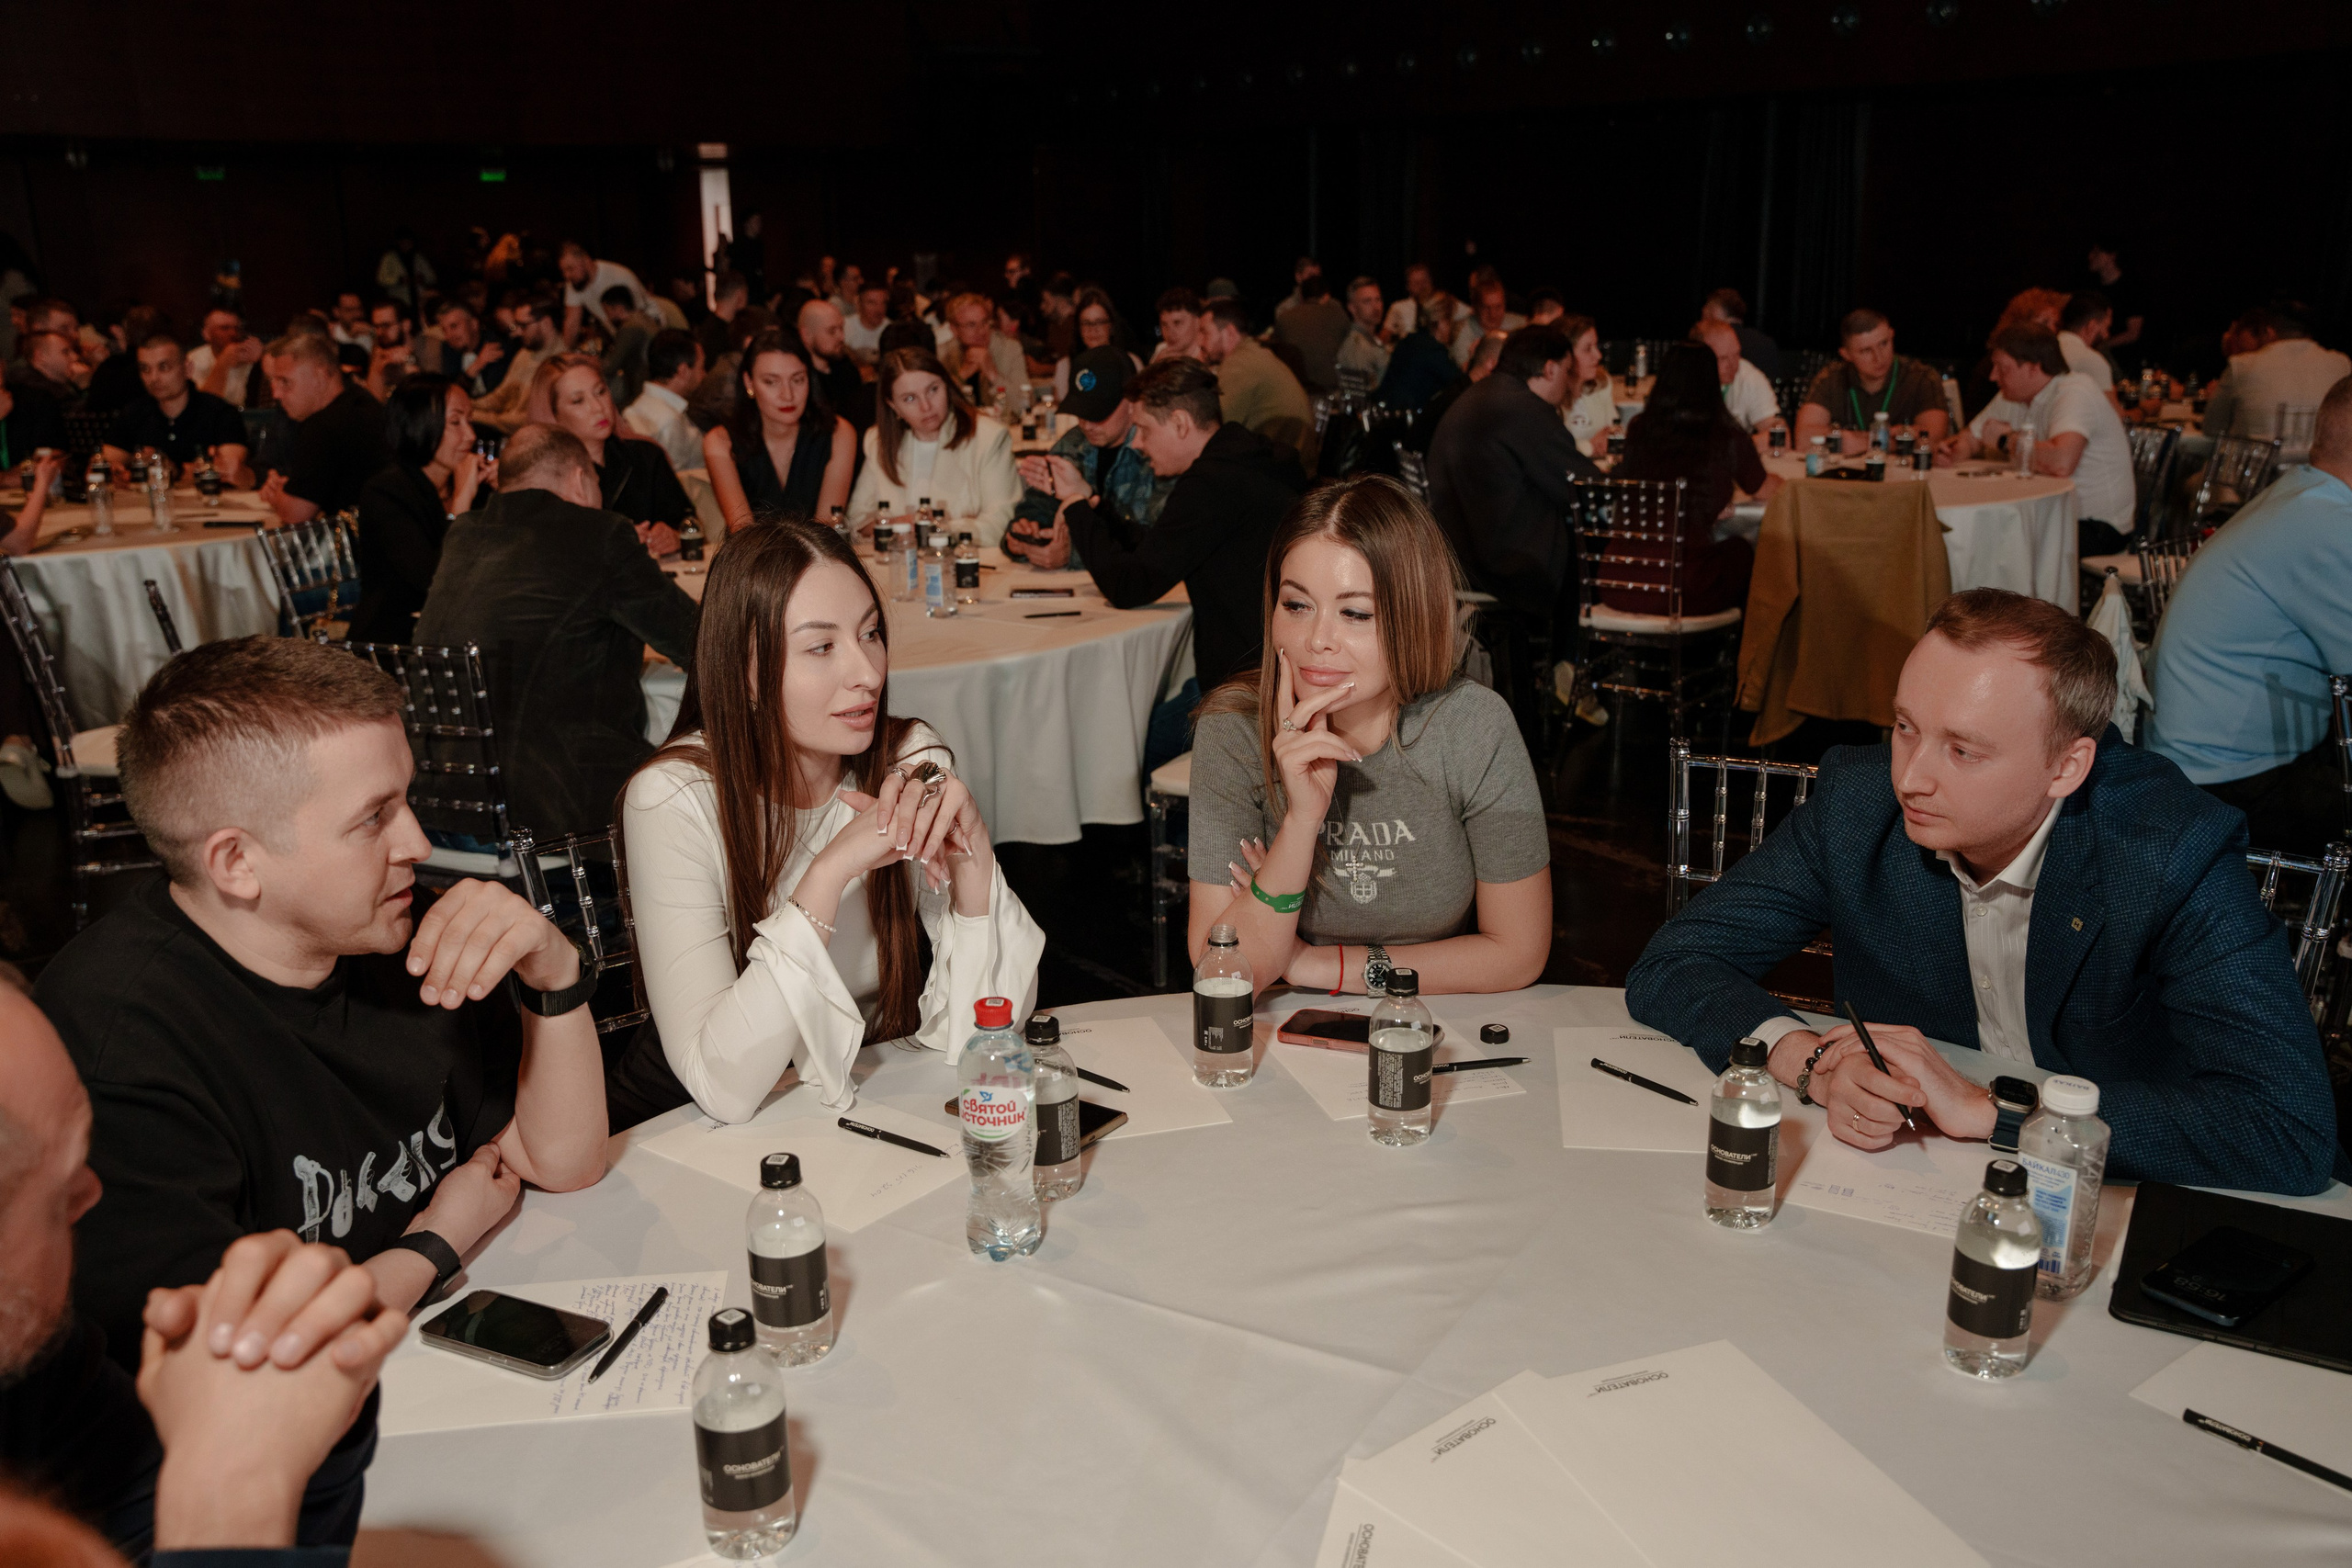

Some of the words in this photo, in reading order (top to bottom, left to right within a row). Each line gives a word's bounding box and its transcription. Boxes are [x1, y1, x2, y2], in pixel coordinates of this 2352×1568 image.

[1330, 849, 1395, 862] MILANO
[963, 1098, 1017, 1115] СВЯТОЙ
[1710, 1144, 1752, 1161] ОСНОВАТЕЛИ
[1595, 1371, 1669, 1393] ОСНОВАТЕЛИ
[1433, 1417, 1497, 1456] ОСНОВАТЕЛИ
